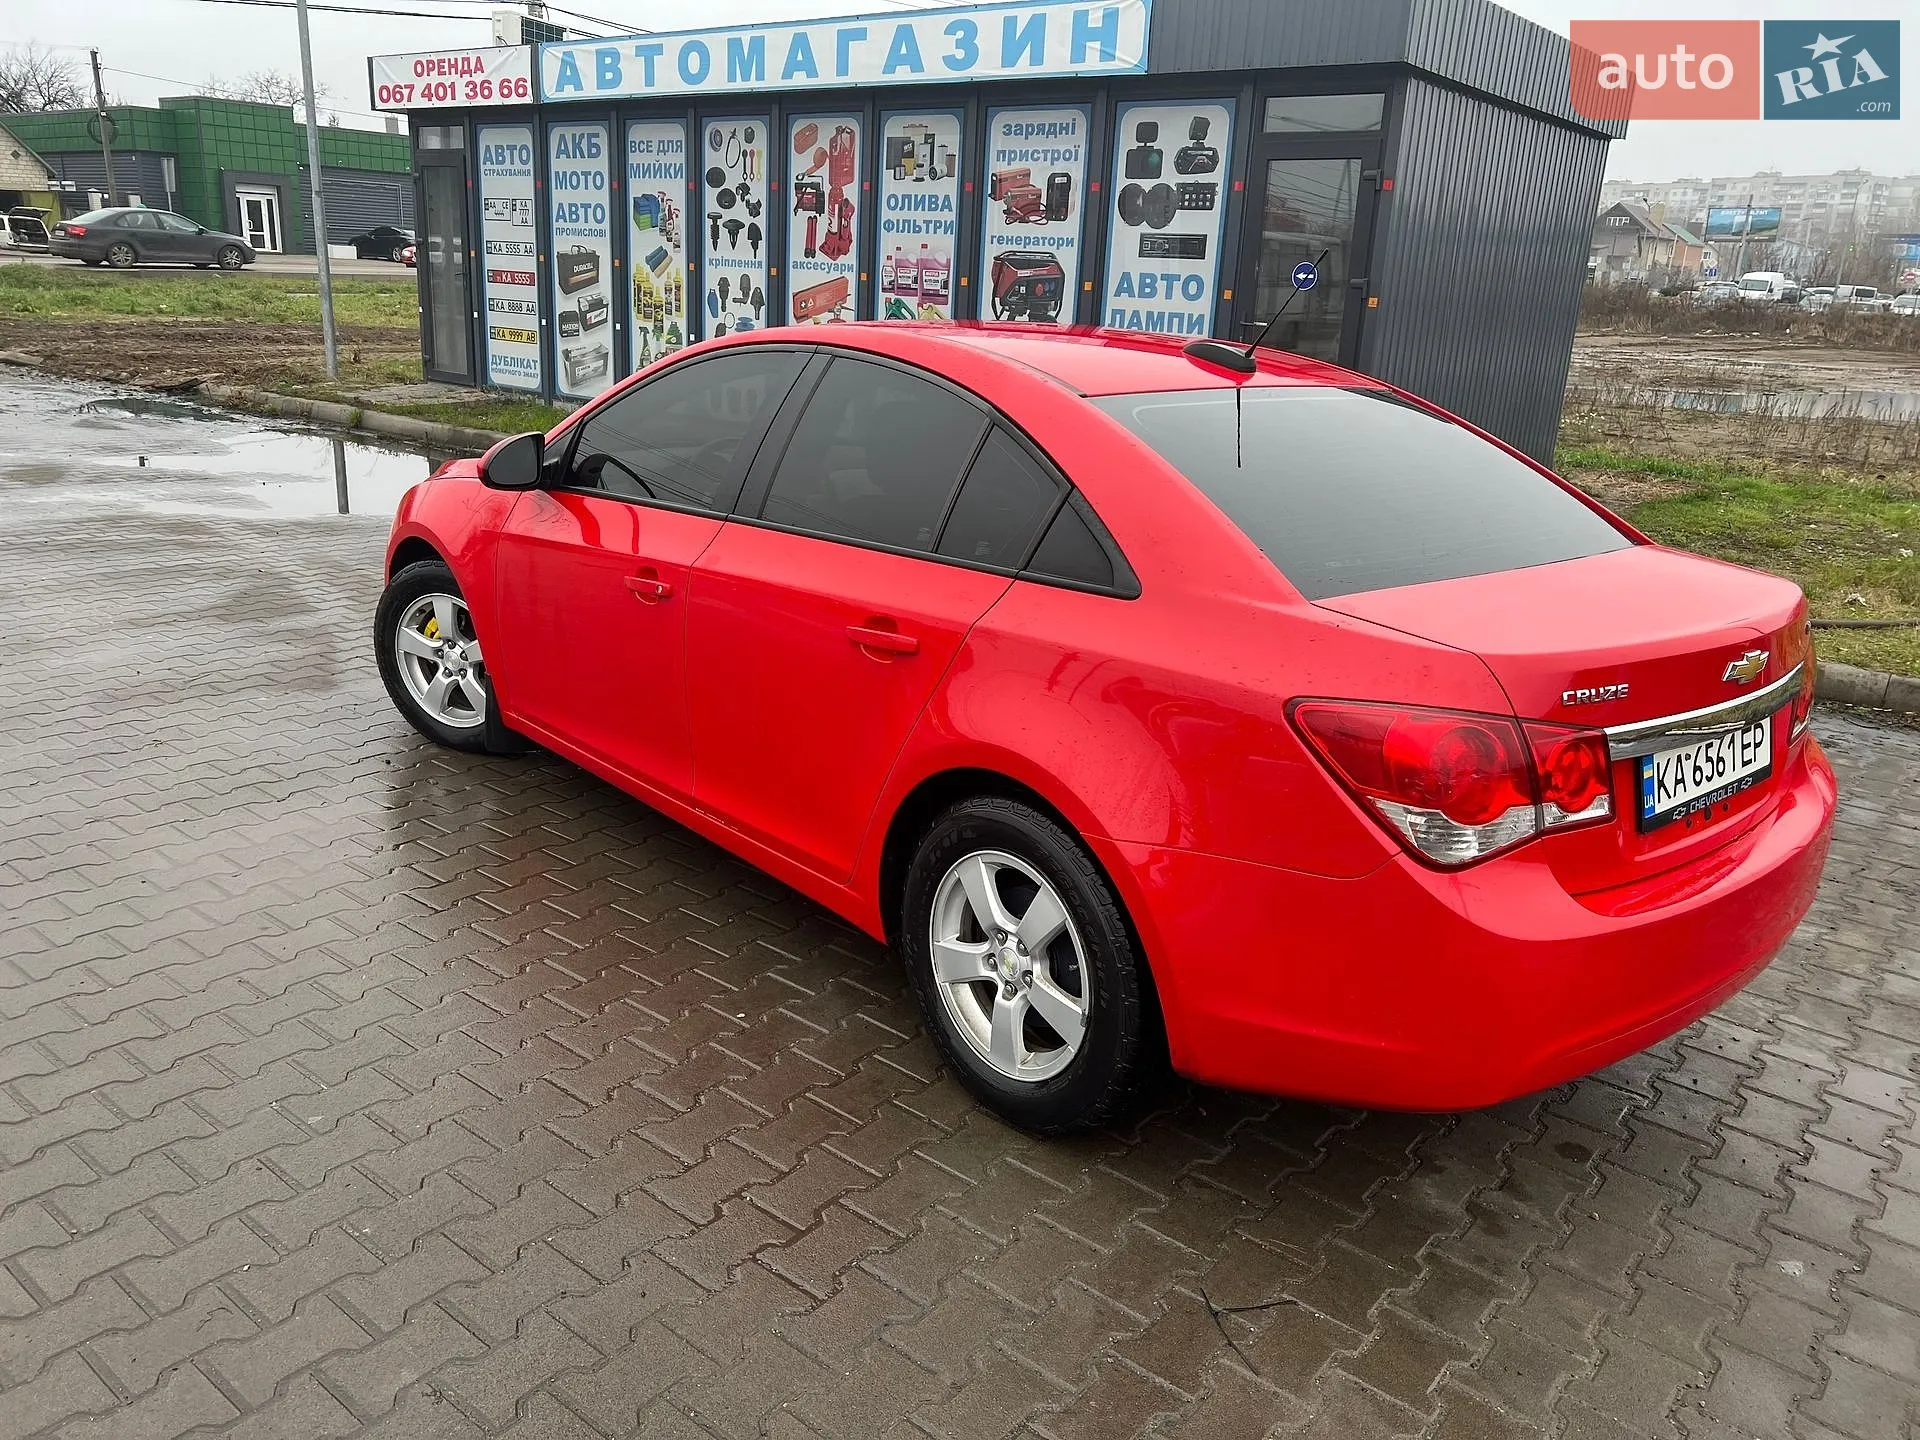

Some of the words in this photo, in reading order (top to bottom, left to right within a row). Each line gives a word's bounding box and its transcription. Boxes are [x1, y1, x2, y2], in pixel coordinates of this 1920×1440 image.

[555, 6, 1120, 93] АВТОМАГАЗИН
[413, 56, 485, 78] ОРЕНДА
[378, 83, 415, 104] 067
[420, 81, 457, 102] 401
[464, 79, 493, 100] 36
[498, 77, 528, 99] 66
[1002, 118, 1076, 140] зарядні
[482, 144, 531, 166] АВТО
[555, 132, 602, 159] АКБ
[629, 140, 653, 154] ВСЕ
[656, 140, 683, 156] ДЛЯ
[996, 144, 1081, 166] пристрої
[483, 168, 532, 177] СТРАХУВАННЯ
[554, 170, 605, 191] МОТО
[629, 159, 684, 180] МИЙКИ
[555, 202, 606, 225] АВТО
[886, 193, 953, 212] ОЛИВА
[555, 227, 607, 238] ПРОМИСЛОВІ
[882, 218, 955, 235] ФІЛЬТРИ
[990, 234, 1075, 250] генератори
[708, 256, 763, 270] кріплення
[792, 260, 854, 274] аксесуари
[1113, 271, 1205, 302] АВТО
[1108, 308, 1205, 336] ЛАМПИ
[491, 354, 538, 370] ДУБЛІКАТ
[1562, 683, 1629, 706] CRUZE
[1689, 782, 1739, 814] CHEVROLET
